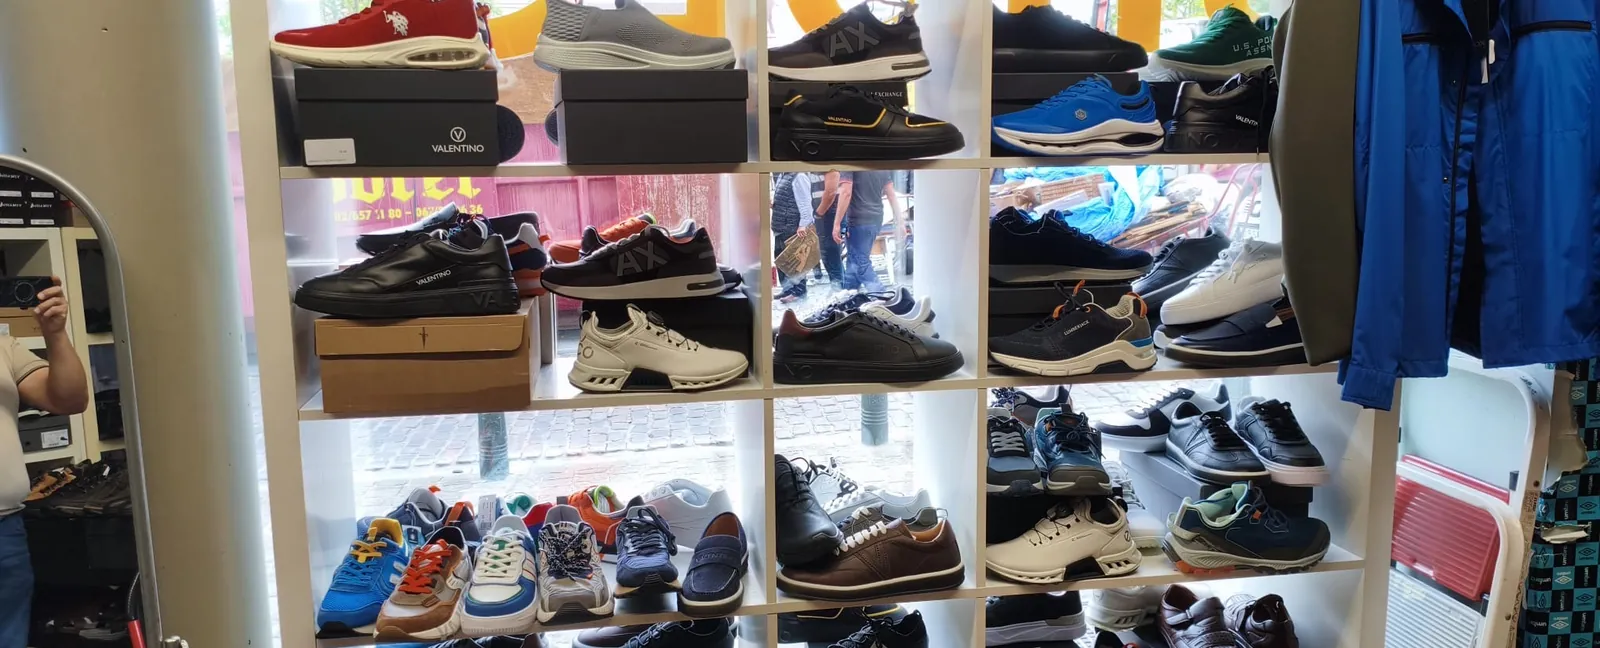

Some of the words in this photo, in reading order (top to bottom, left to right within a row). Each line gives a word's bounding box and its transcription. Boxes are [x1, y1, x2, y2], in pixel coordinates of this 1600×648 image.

[830, 21, 880, 58] AX
[431, 144, 485, 153] VALENTINO
[617, 241, 668, 276] AX
[415, 269, 452, 286] VALENTINO
